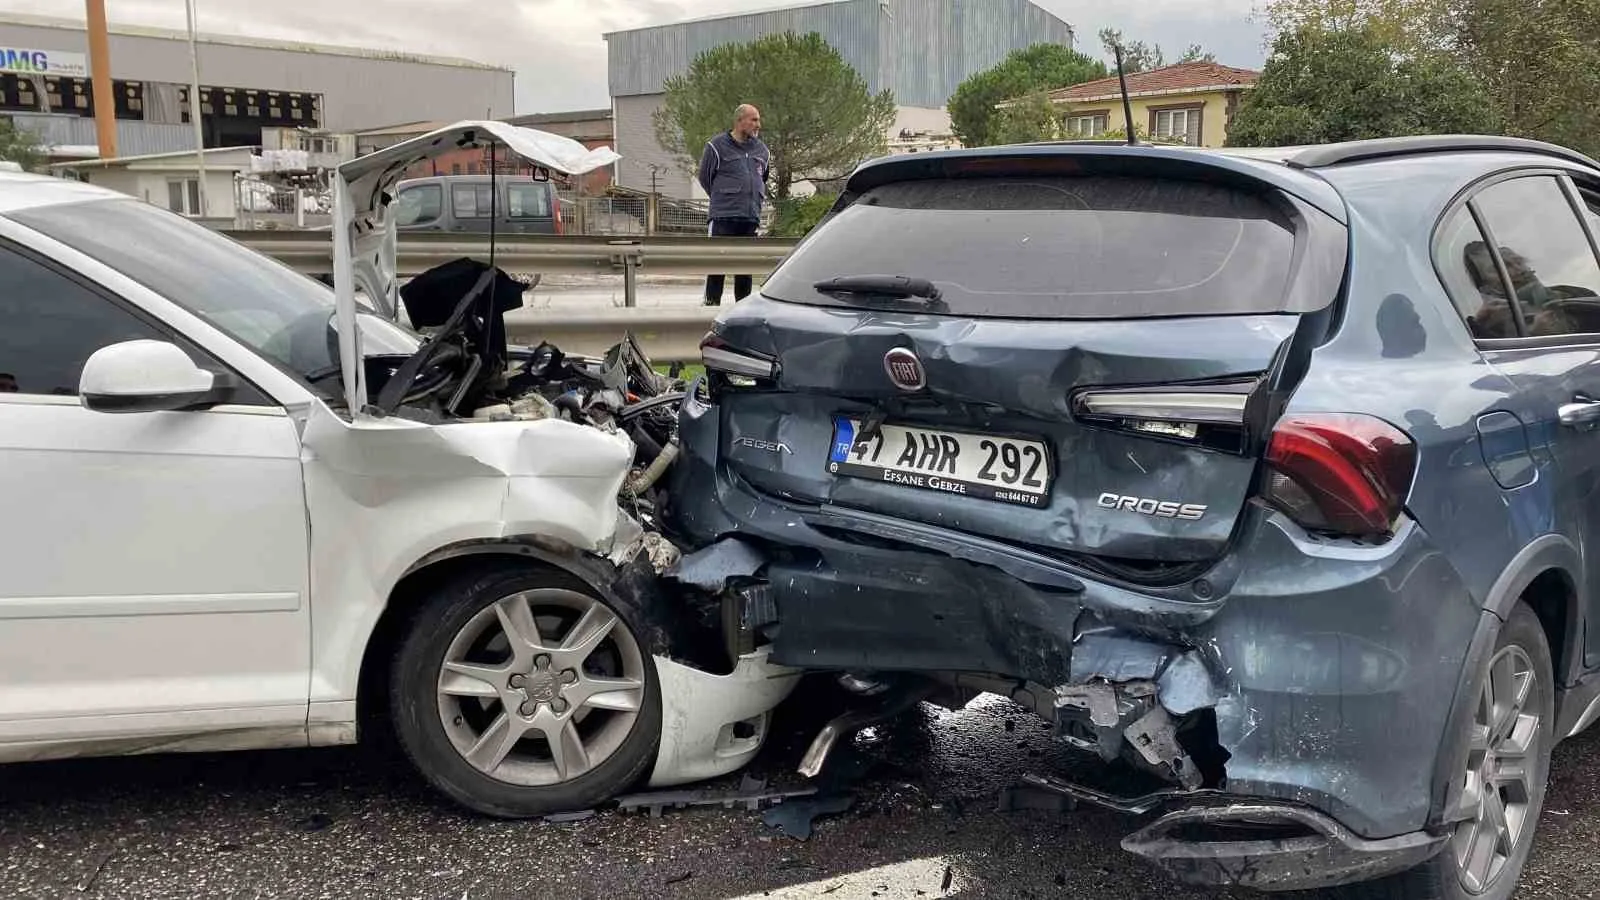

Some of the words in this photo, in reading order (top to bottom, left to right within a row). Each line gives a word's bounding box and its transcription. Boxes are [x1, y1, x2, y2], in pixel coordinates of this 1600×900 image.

[892, 361, 917, 381] FIAT
[837, 442, 849, 456] TR
[896, 431, 961, 474] AHR
[977, 439, 1042, 488] 292
[1098, 492, 1209, 520] CROSS
